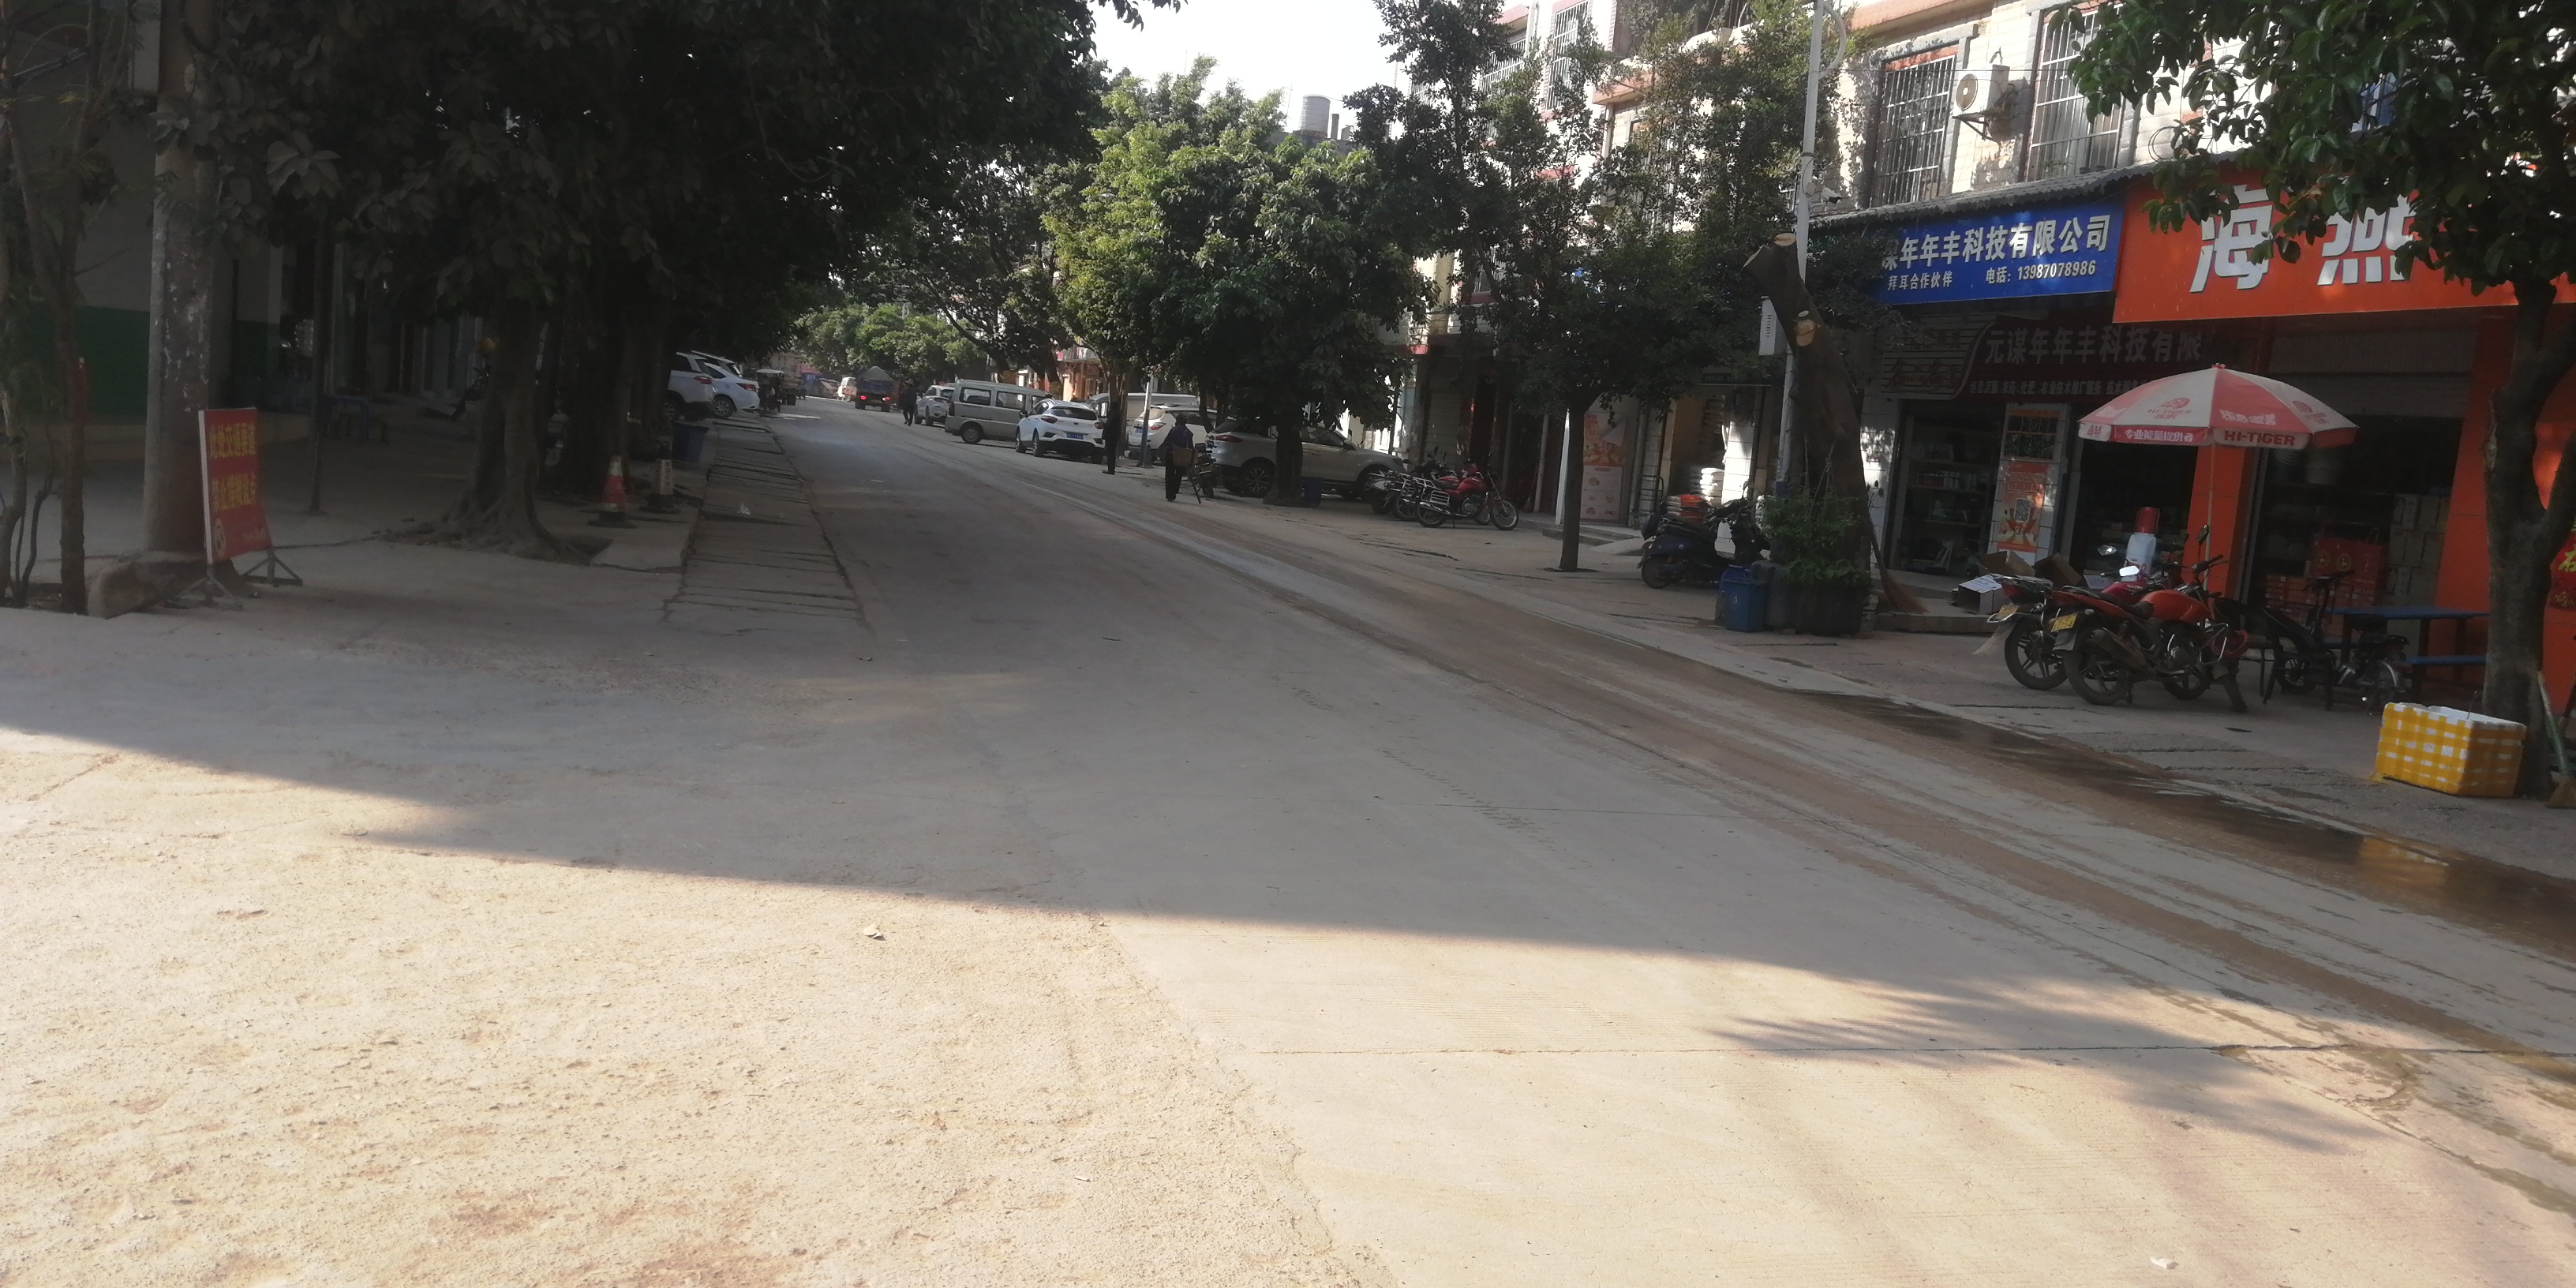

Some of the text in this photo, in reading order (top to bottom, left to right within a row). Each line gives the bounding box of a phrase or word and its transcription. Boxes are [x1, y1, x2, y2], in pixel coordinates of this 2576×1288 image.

[1887, 271, 1953, 291] 拜耳合作伙伴
[2224, 430, 2296, 447] HI-TIGER
